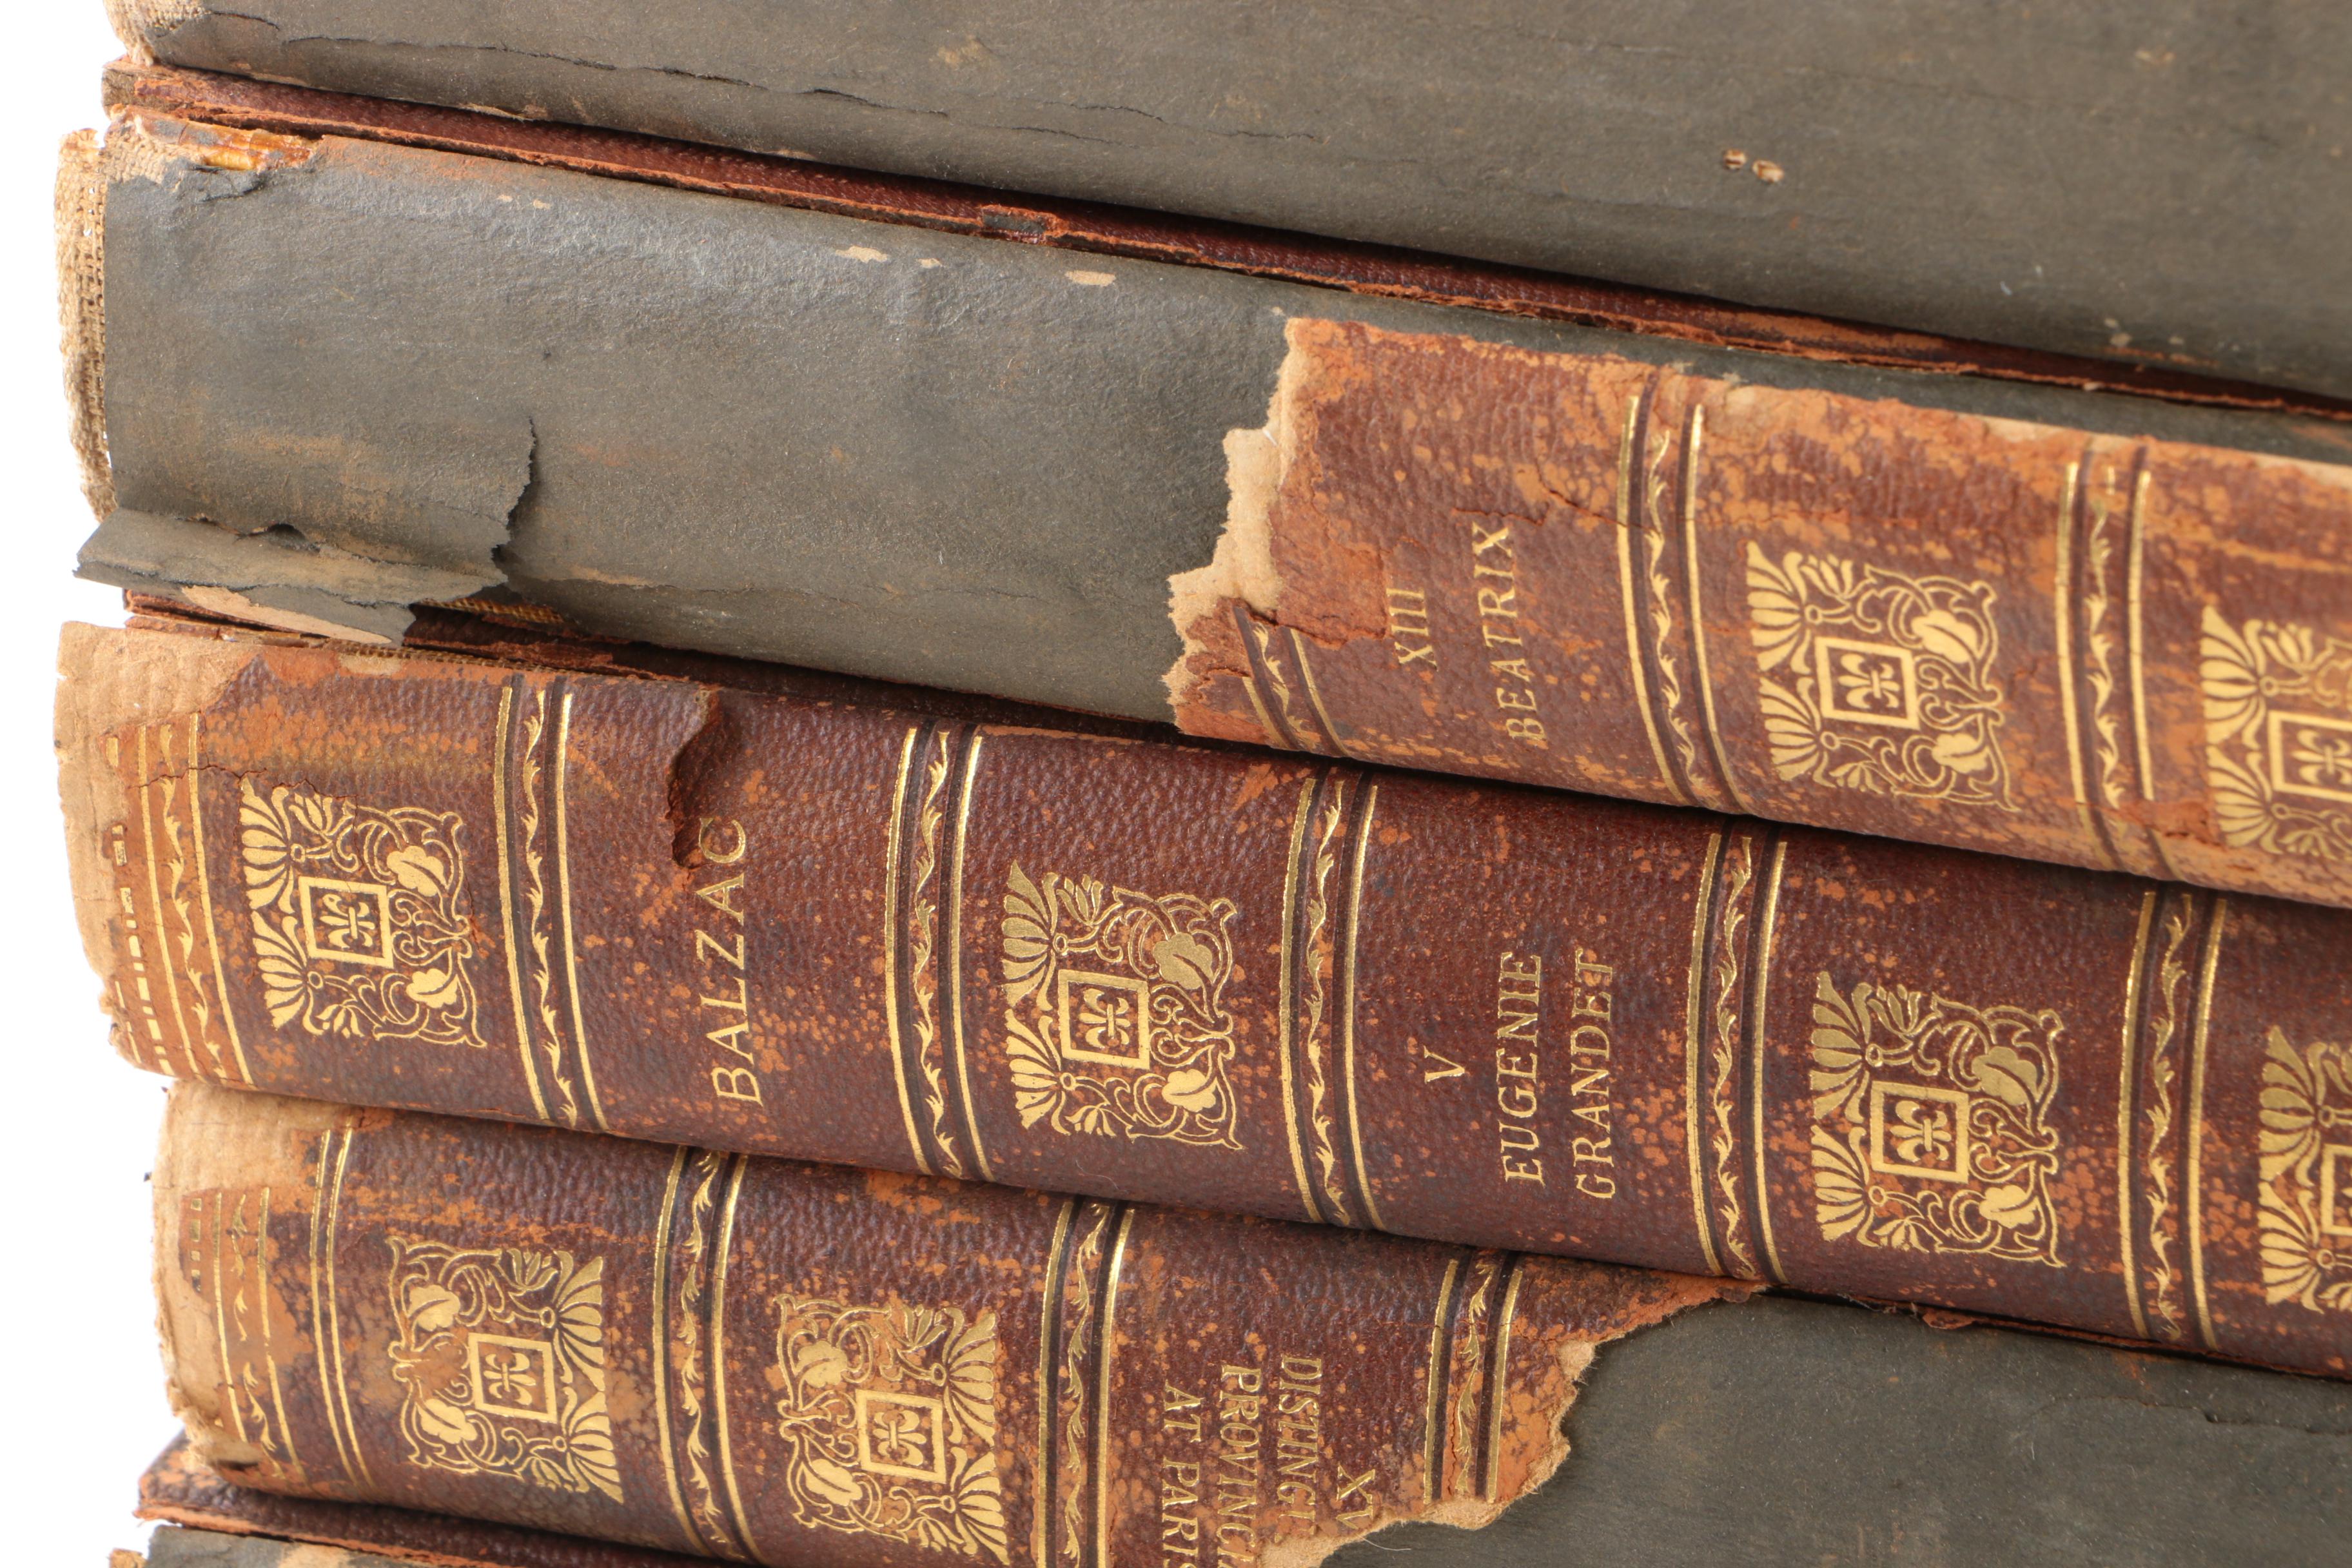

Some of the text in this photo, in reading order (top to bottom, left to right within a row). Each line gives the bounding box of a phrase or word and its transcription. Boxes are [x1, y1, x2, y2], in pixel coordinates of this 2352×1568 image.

[1386, 587, 1438, 671] XIII
[1472, 521, 1547, 741] BEATRIX
[696, 818, 763, 1106] BALZAC
[1424, 1046, 1465, 1083] V
[1496, 952, 1545, 1188] EUGENIE
[1570, 946, 1616, 1199] GRANDET
[1164, 1380, 1204, 1443] AT
[1217, 1364, 1262, 1568] PROVINCI
